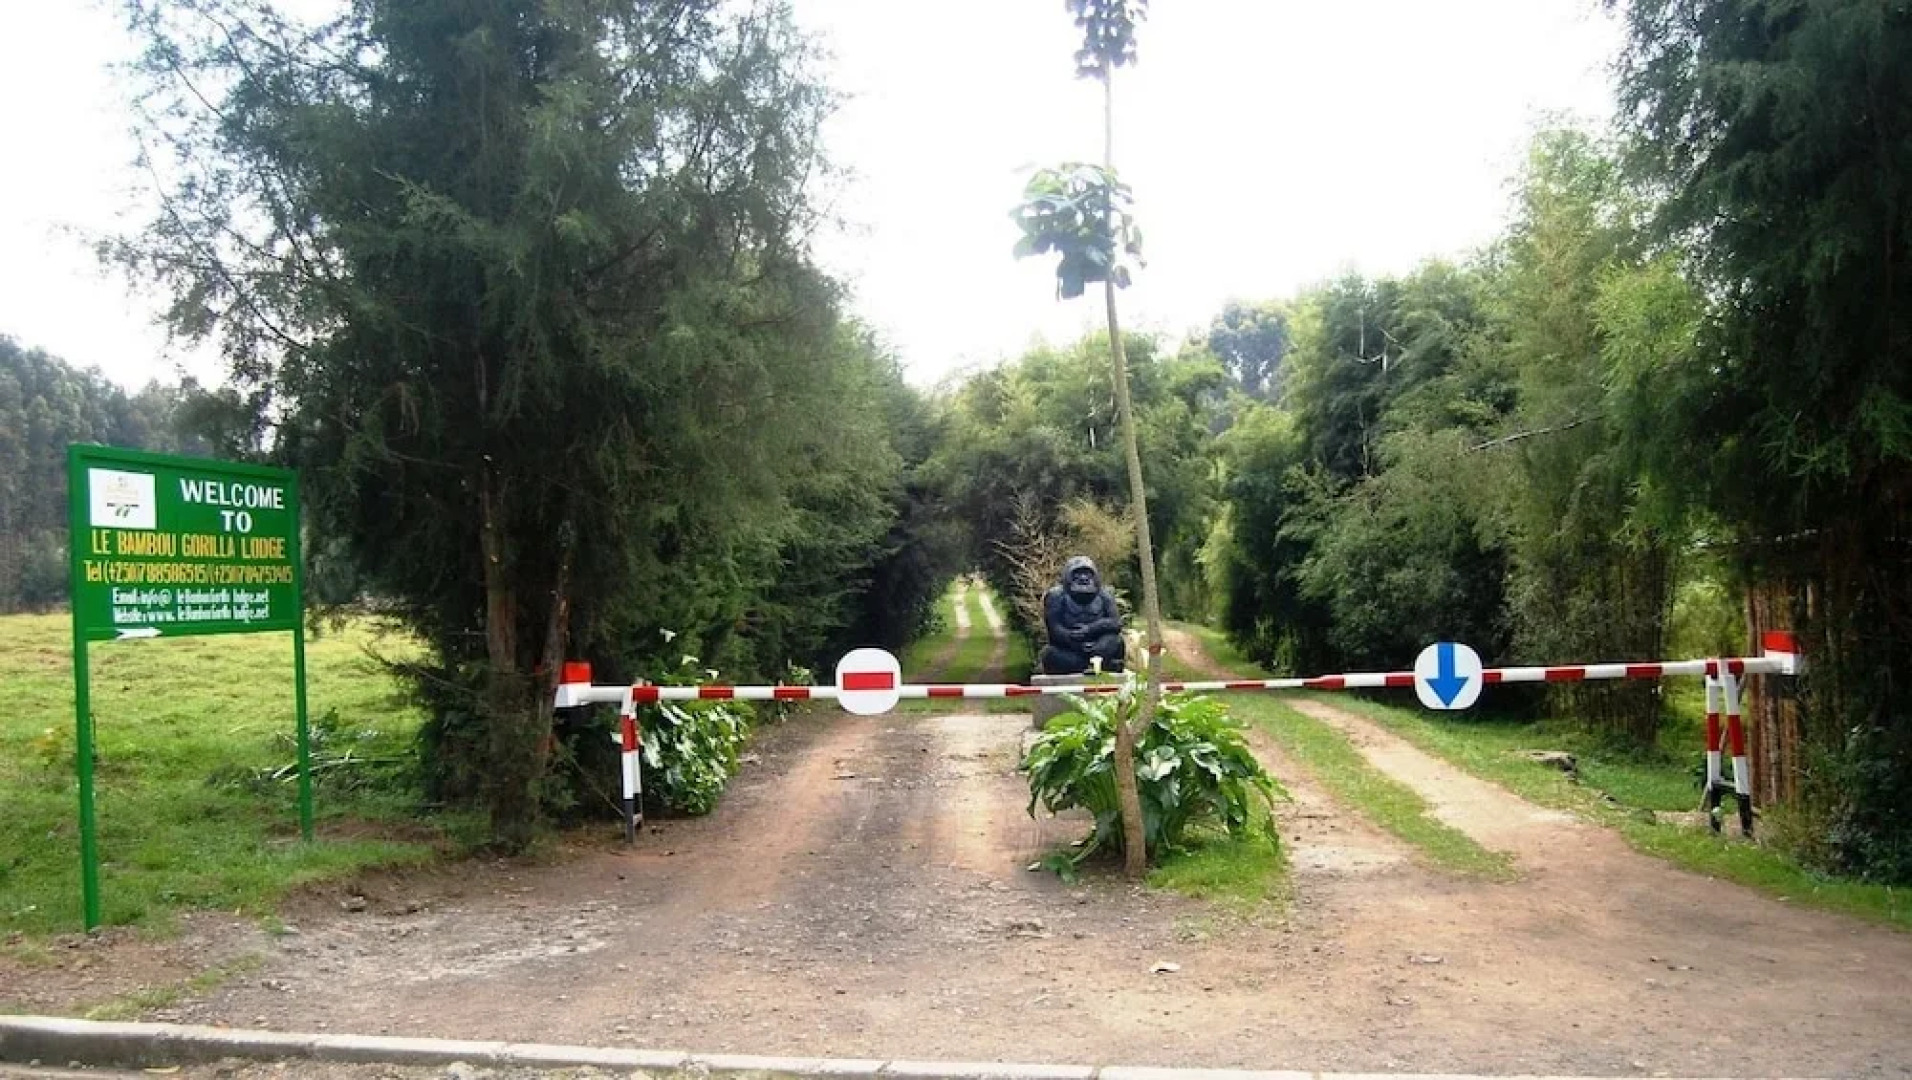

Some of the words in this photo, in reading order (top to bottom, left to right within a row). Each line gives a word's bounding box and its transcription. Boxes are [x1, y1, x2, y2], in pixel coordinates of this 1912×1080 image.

[179, 477, 284, 509] WELCOME
[220, 510, 253, 533] TO
[91, 529, 112, 555] LE
[118, 532, 177, 557] BAMBOU
[181, 533, 235, 558] GORILLA
[241, 538, 286, 559] LODGE
